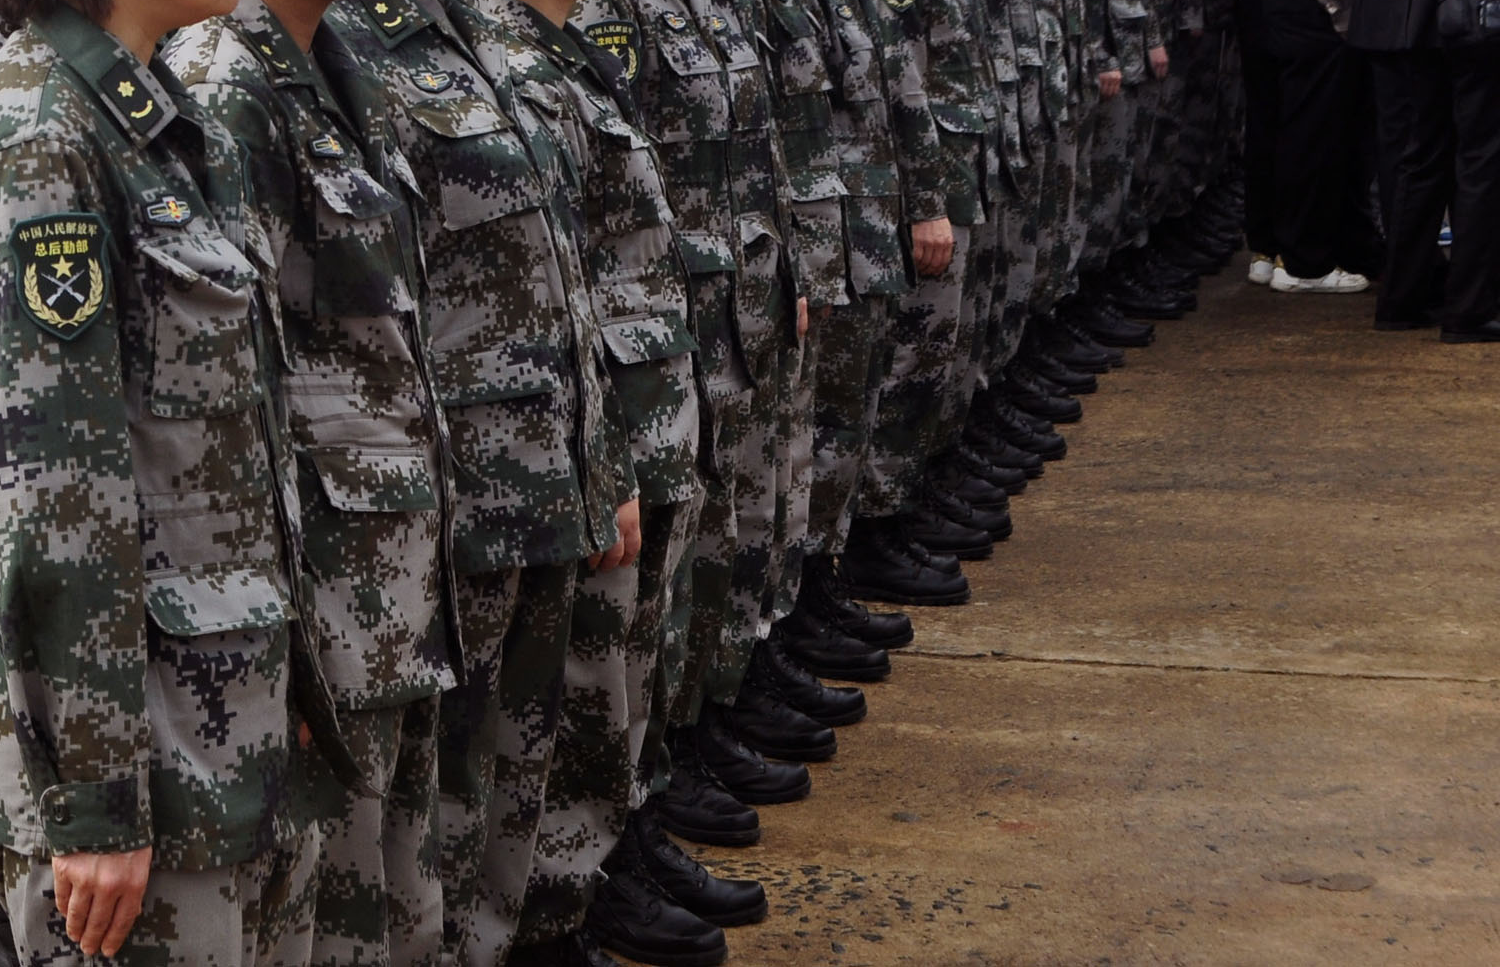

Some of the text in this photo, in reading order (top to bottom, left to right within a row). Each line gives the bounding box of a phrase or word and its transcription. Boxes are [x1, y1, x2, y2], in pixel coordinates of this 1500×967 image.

[19, 221, 98, 242] 中国人民解放军
[34, 238, 89, 257] 总后勤部
